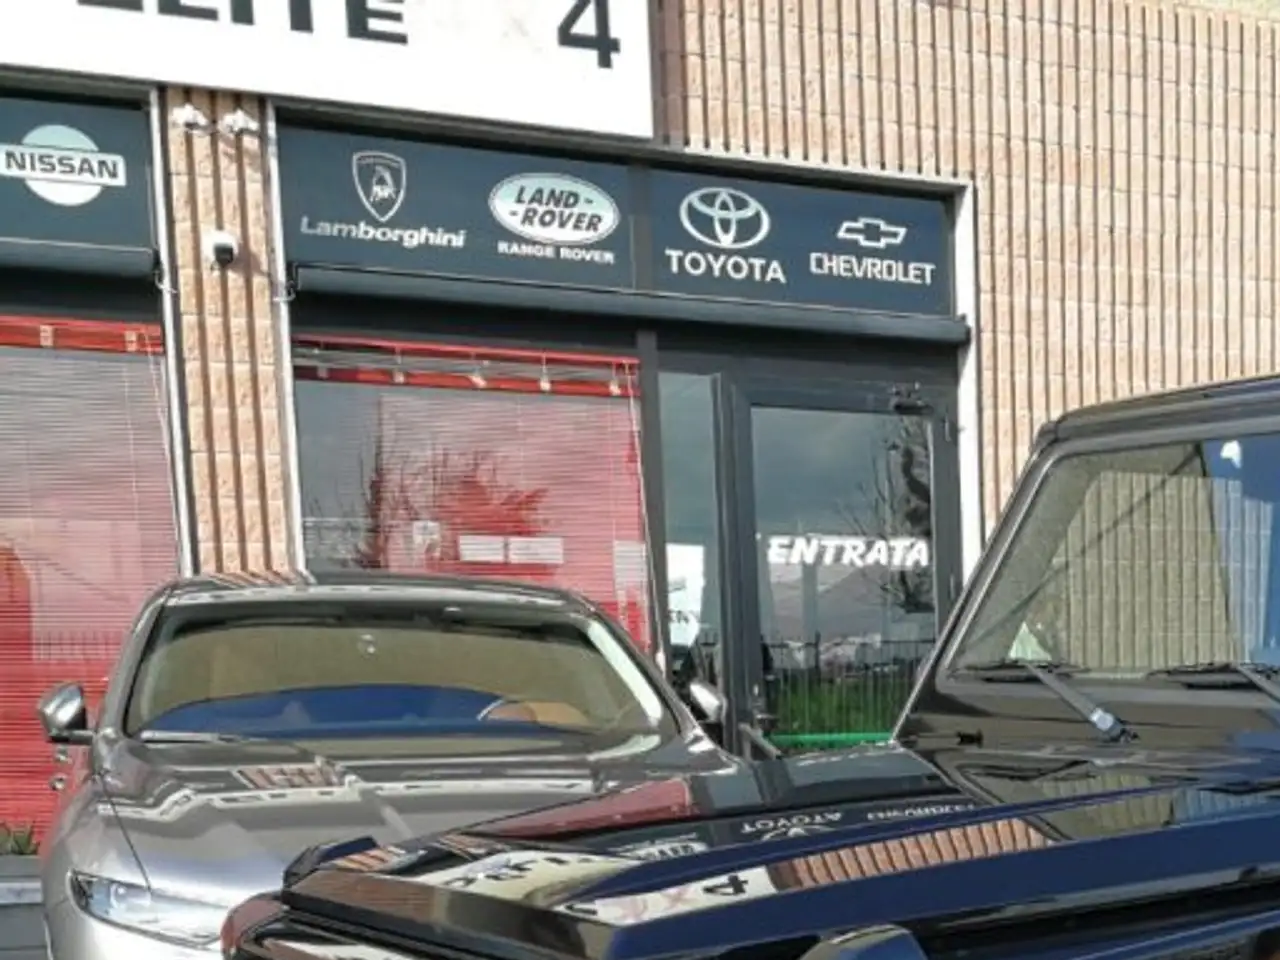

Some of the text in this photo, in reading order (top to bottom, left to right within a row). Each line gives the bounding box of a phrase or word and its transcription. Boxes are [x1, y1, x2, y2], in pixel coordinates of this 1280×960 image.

[5, 151, 119, 179] NISSAN
[300, 216, 468, 248] Lamborghini
[497, 239, 616, 265] RANGE ROVER
[665, 248, 787, 284] TOYOTA
[809, 252, 937, 285] CHEVROLET
[766, 534, 931, 567] ENTRATA
